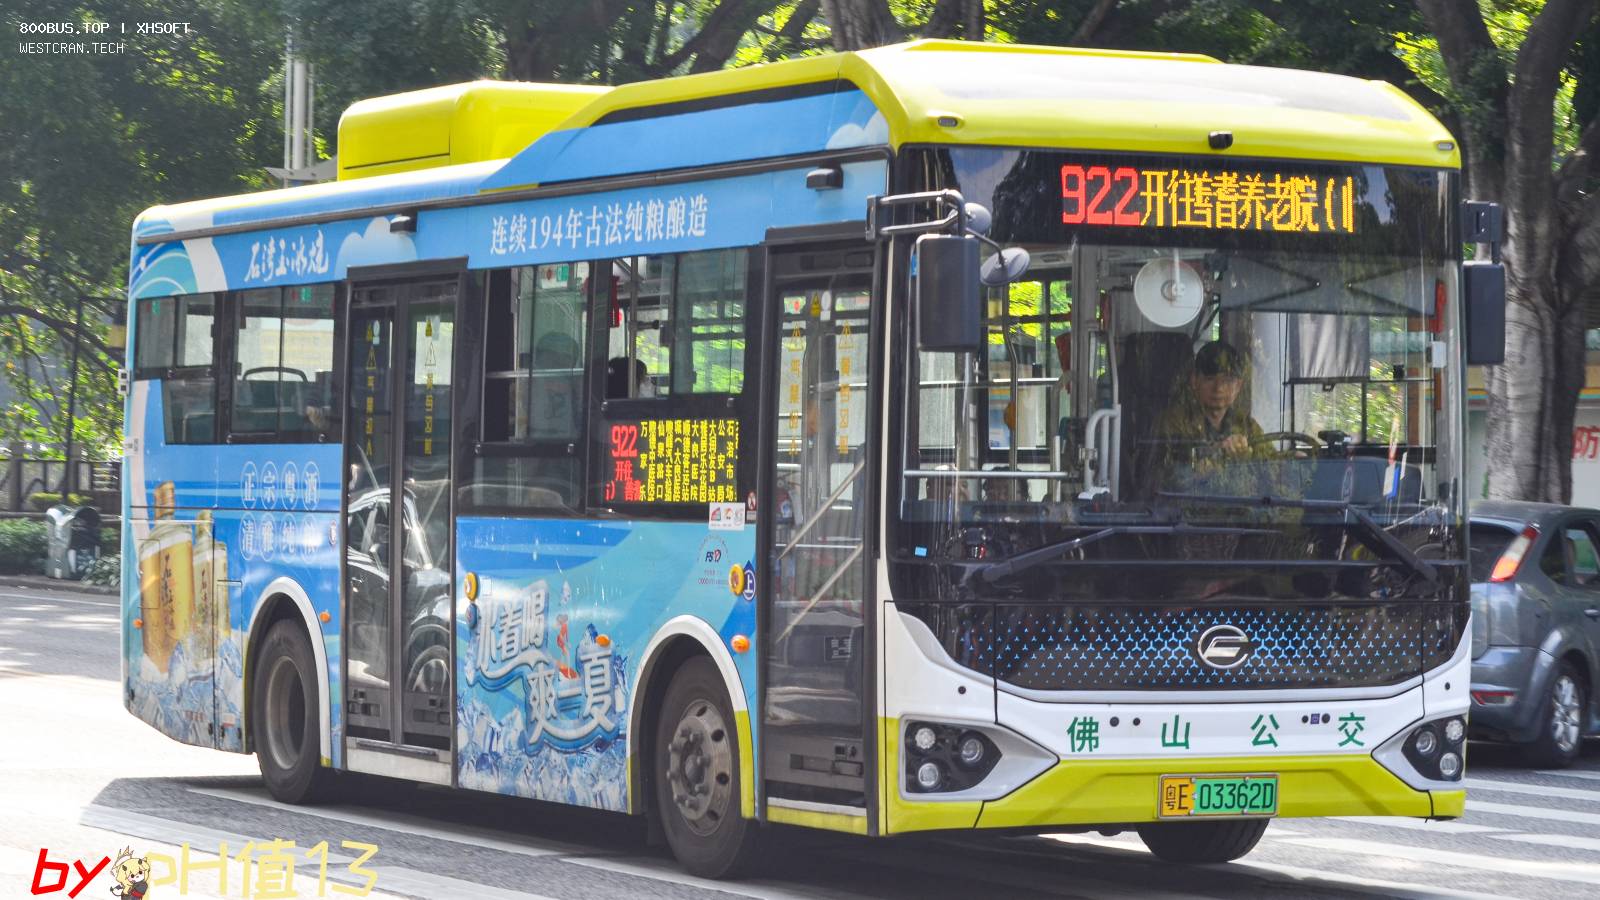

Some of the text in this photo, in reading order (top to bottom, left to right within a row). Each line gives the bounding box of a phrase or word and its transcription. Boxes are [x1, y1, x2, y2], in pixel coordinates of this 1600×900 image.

[1061, 165, 1140, 226] 922
[490, 193, 708, 256] 连续194年古法纯粮酿造
[611, 425, 638, 457] 922
[690, 420, 699, 501] 大良医院
[717, 420, 726, 503] 公安局
[243, 470, 319, 505] 正宗粤酒
[615, 461, 633, 481] 开往
[526, 645, 615, 747] 爽一夏
[1066, 711, 1366, 753] 佛山公交
[1164, 782, 1275, 811] 粤E 03362D
